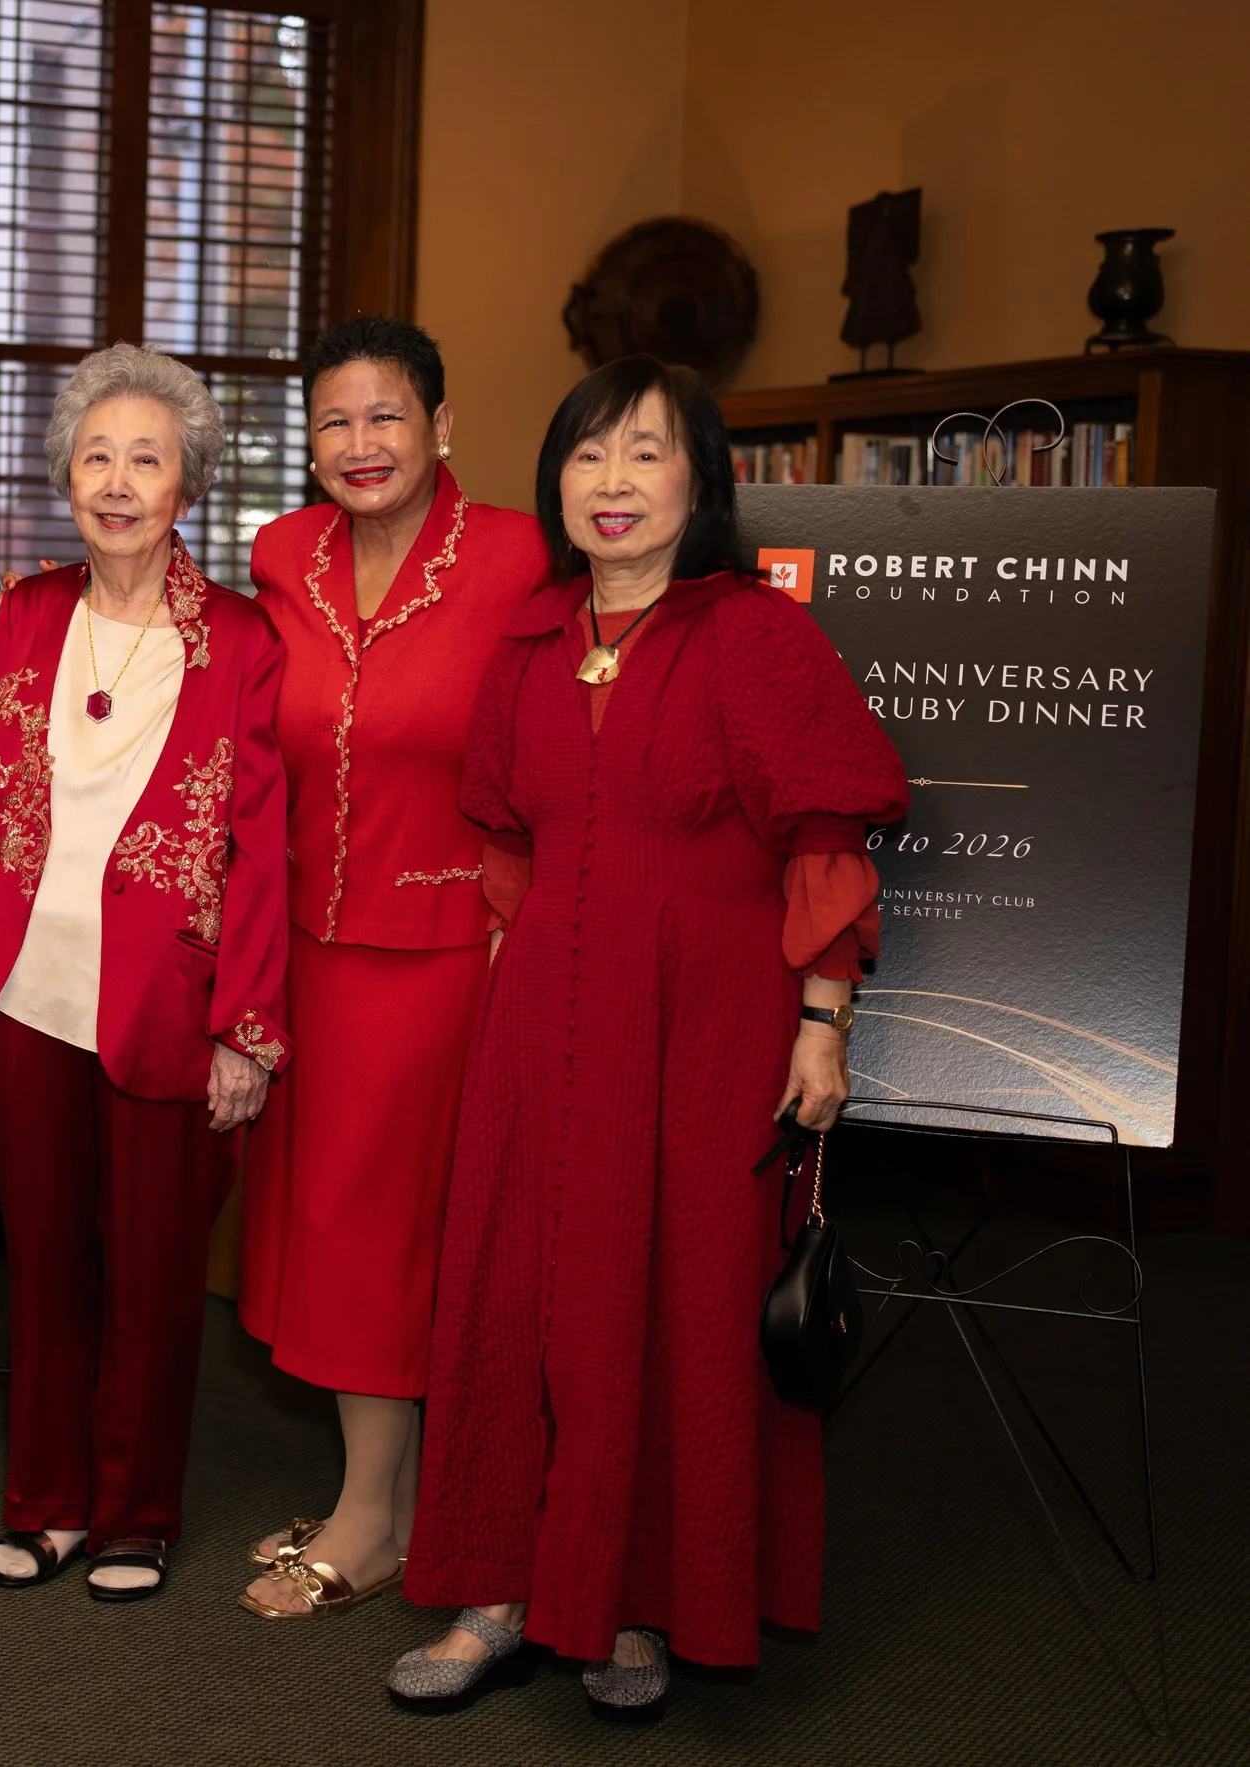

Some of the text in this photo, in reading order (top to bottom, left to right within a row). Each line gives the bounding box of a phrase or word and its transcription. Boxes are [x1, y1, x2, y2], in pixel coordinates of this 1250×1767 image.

[828, 554, 1129, 582] ROBERT CHINN
[827, 584, 1125, 605] FOUNDATION
[864, 660, 1154, 692] ANNIVERSARY
[868, 695, 1147, 729] RUBY DINNER
[866, 828, 1034, 859] 6 to 2026
[877, 904, 963, 920] F SEATTLE
[883, 888, 1035, 908] UNIVERSITY CLUB
